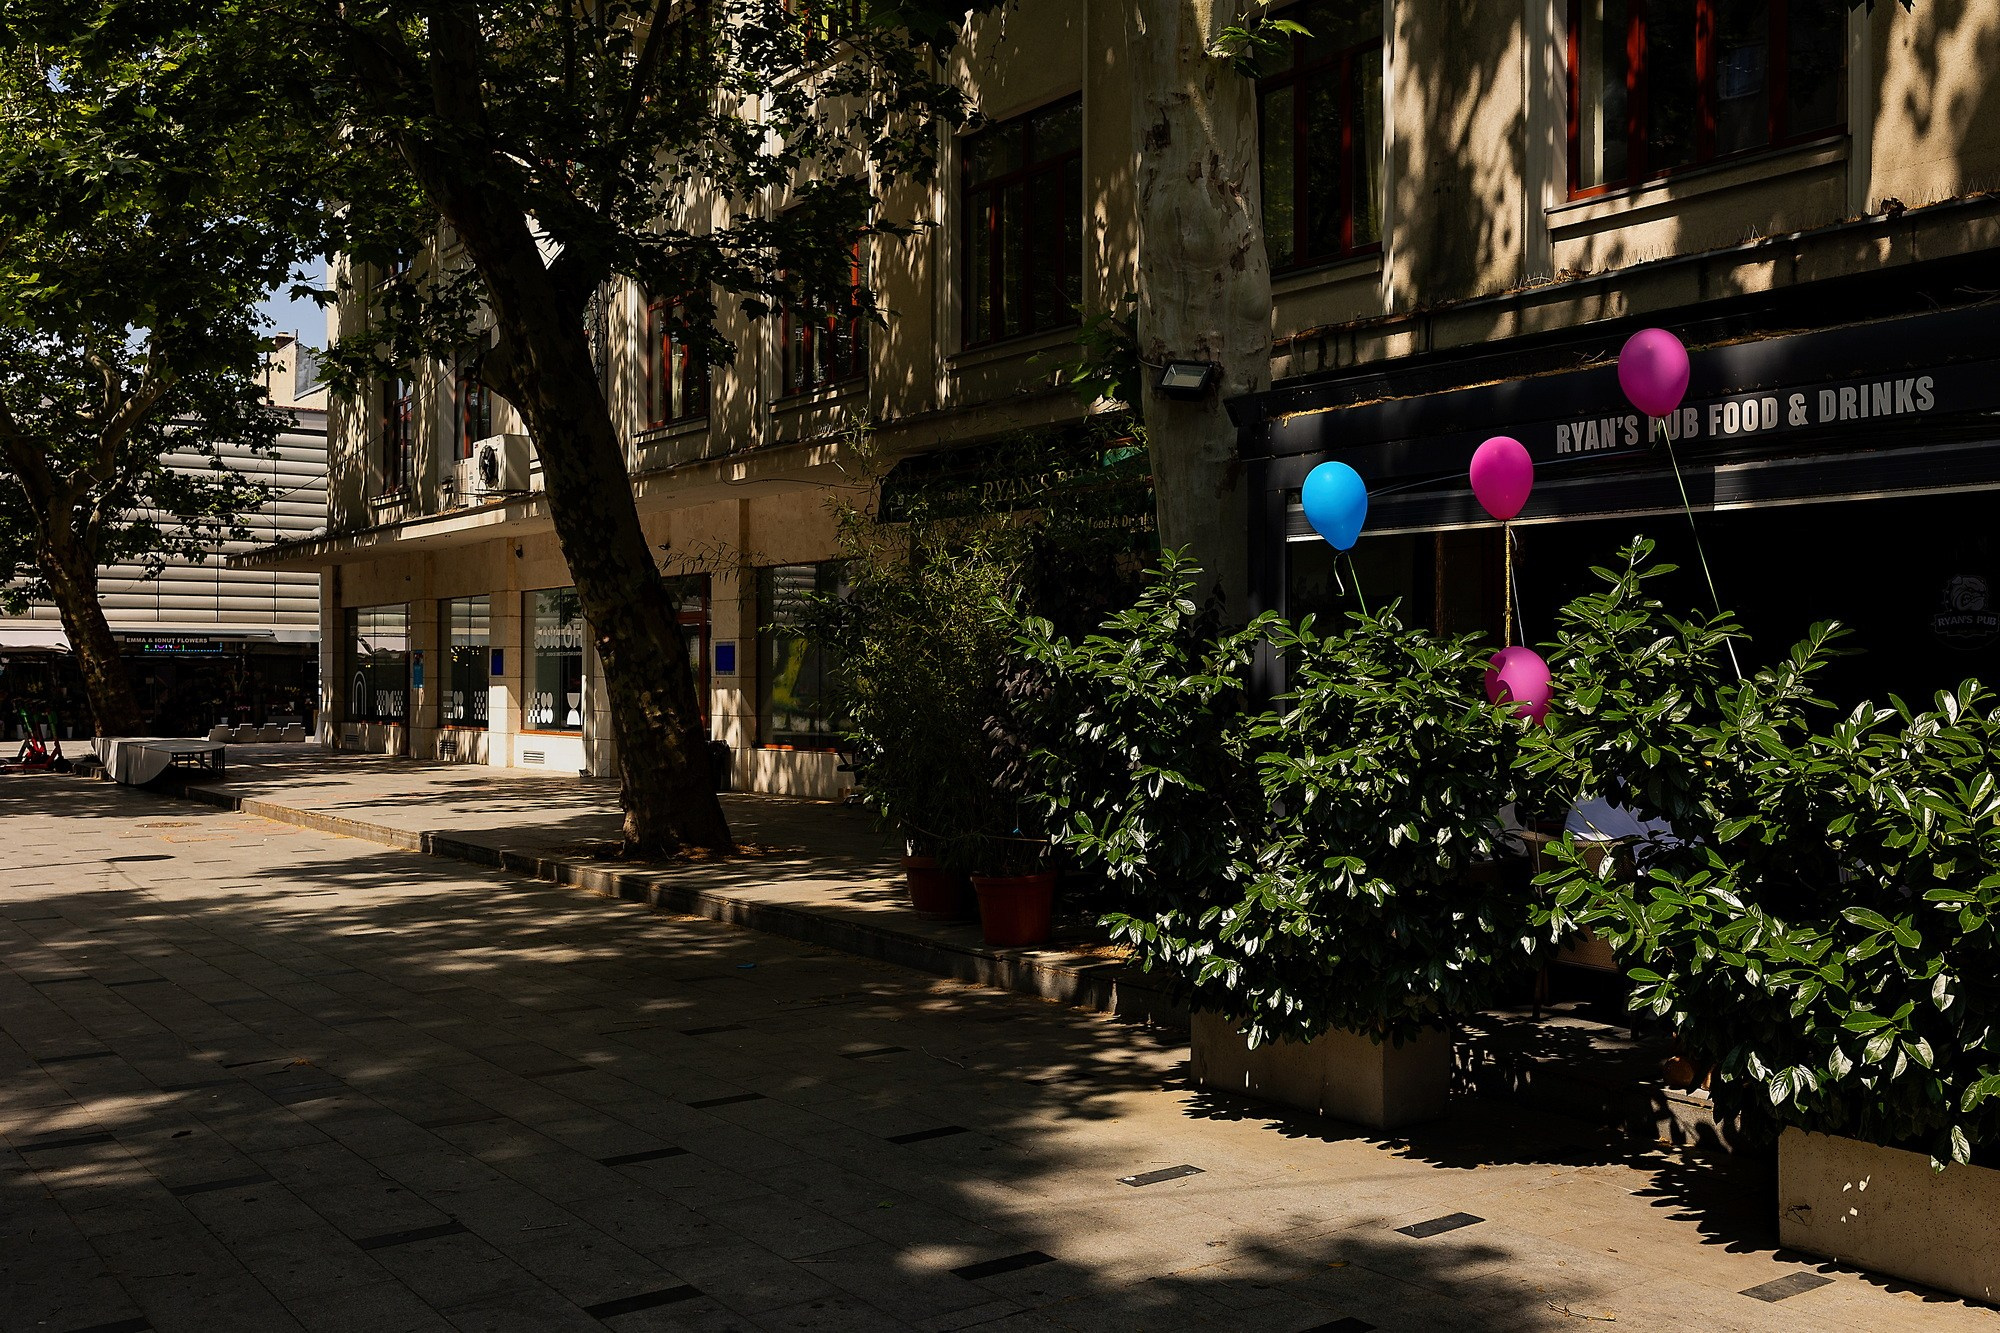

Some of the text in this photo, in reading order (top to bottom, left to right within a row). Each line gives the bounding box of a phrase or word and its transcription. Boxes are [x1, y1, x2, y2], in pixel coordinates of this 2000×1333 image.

[1556, 375, 1935, 454] RYAN'S PUB FOOD & DRINKS
[1977, 615, 1997, 626] PUB
